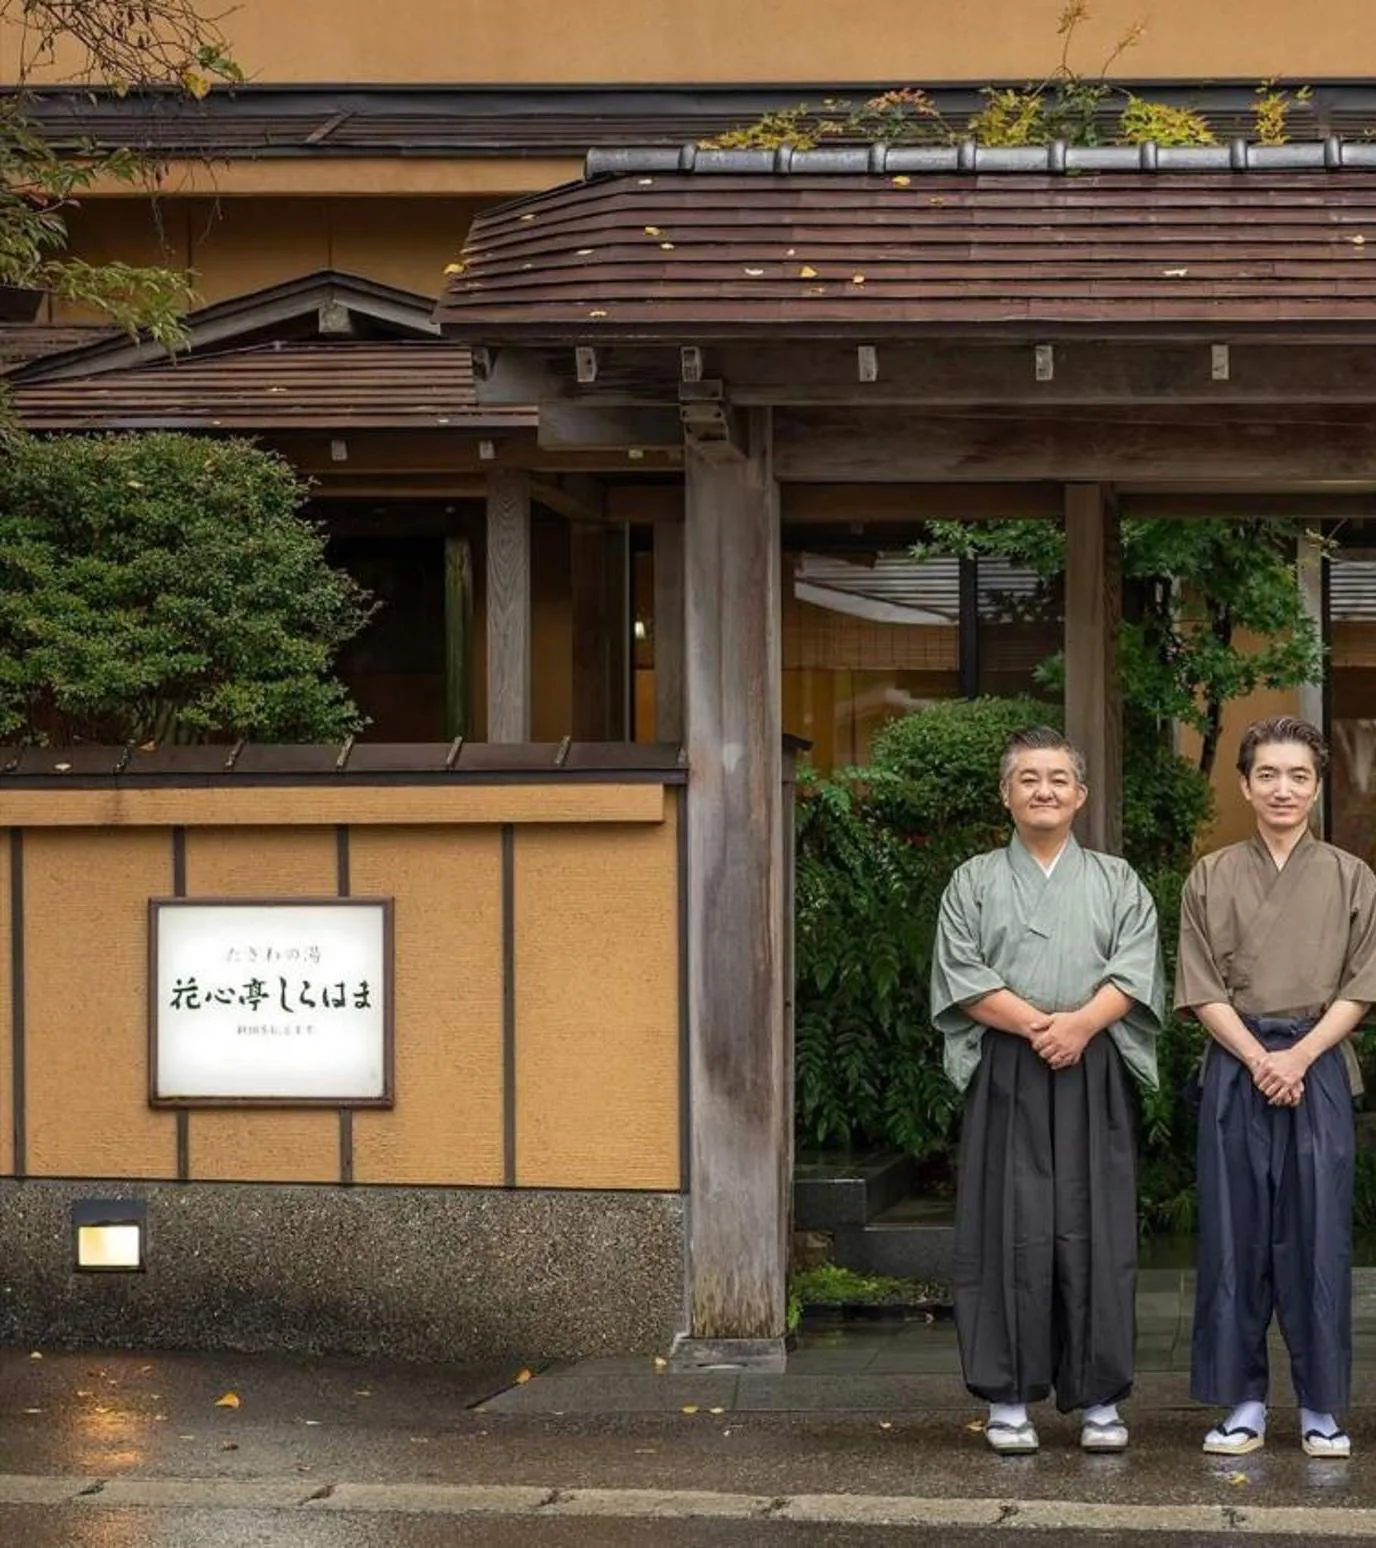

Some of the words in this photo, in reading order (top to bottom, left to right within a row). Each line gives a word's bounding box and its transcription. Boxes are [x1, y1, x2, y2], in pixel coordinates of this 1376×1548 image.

[169, 976, 372, 1013] 花心亭しらはま
